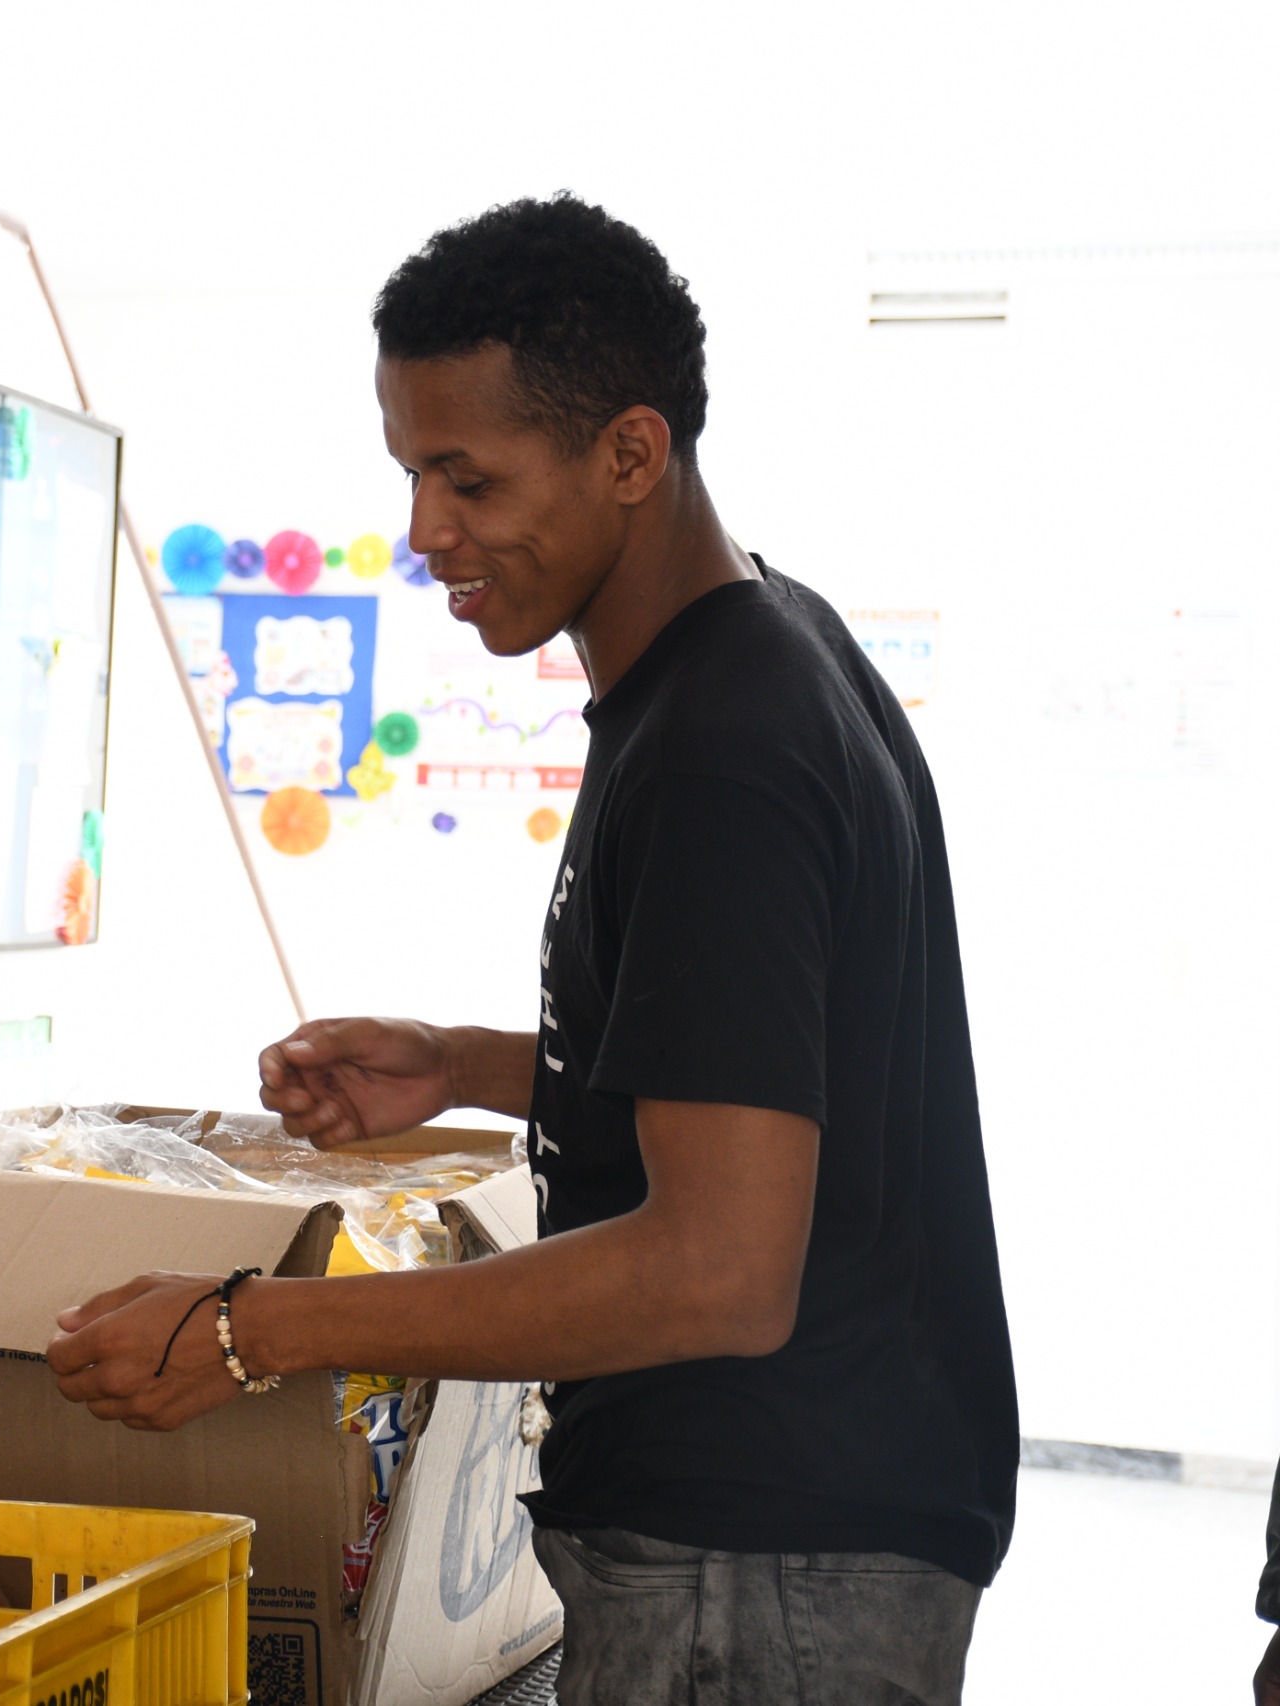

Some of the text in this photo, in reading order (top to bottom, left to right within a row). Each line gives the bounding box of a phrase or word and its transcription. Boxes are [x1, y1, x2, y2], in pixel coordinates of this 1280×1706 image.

[279, 1586, 317, 1599] OnLine
[257, 1598, 295, 1608] nuestra
[295, 1598, 317, 1609] Web
